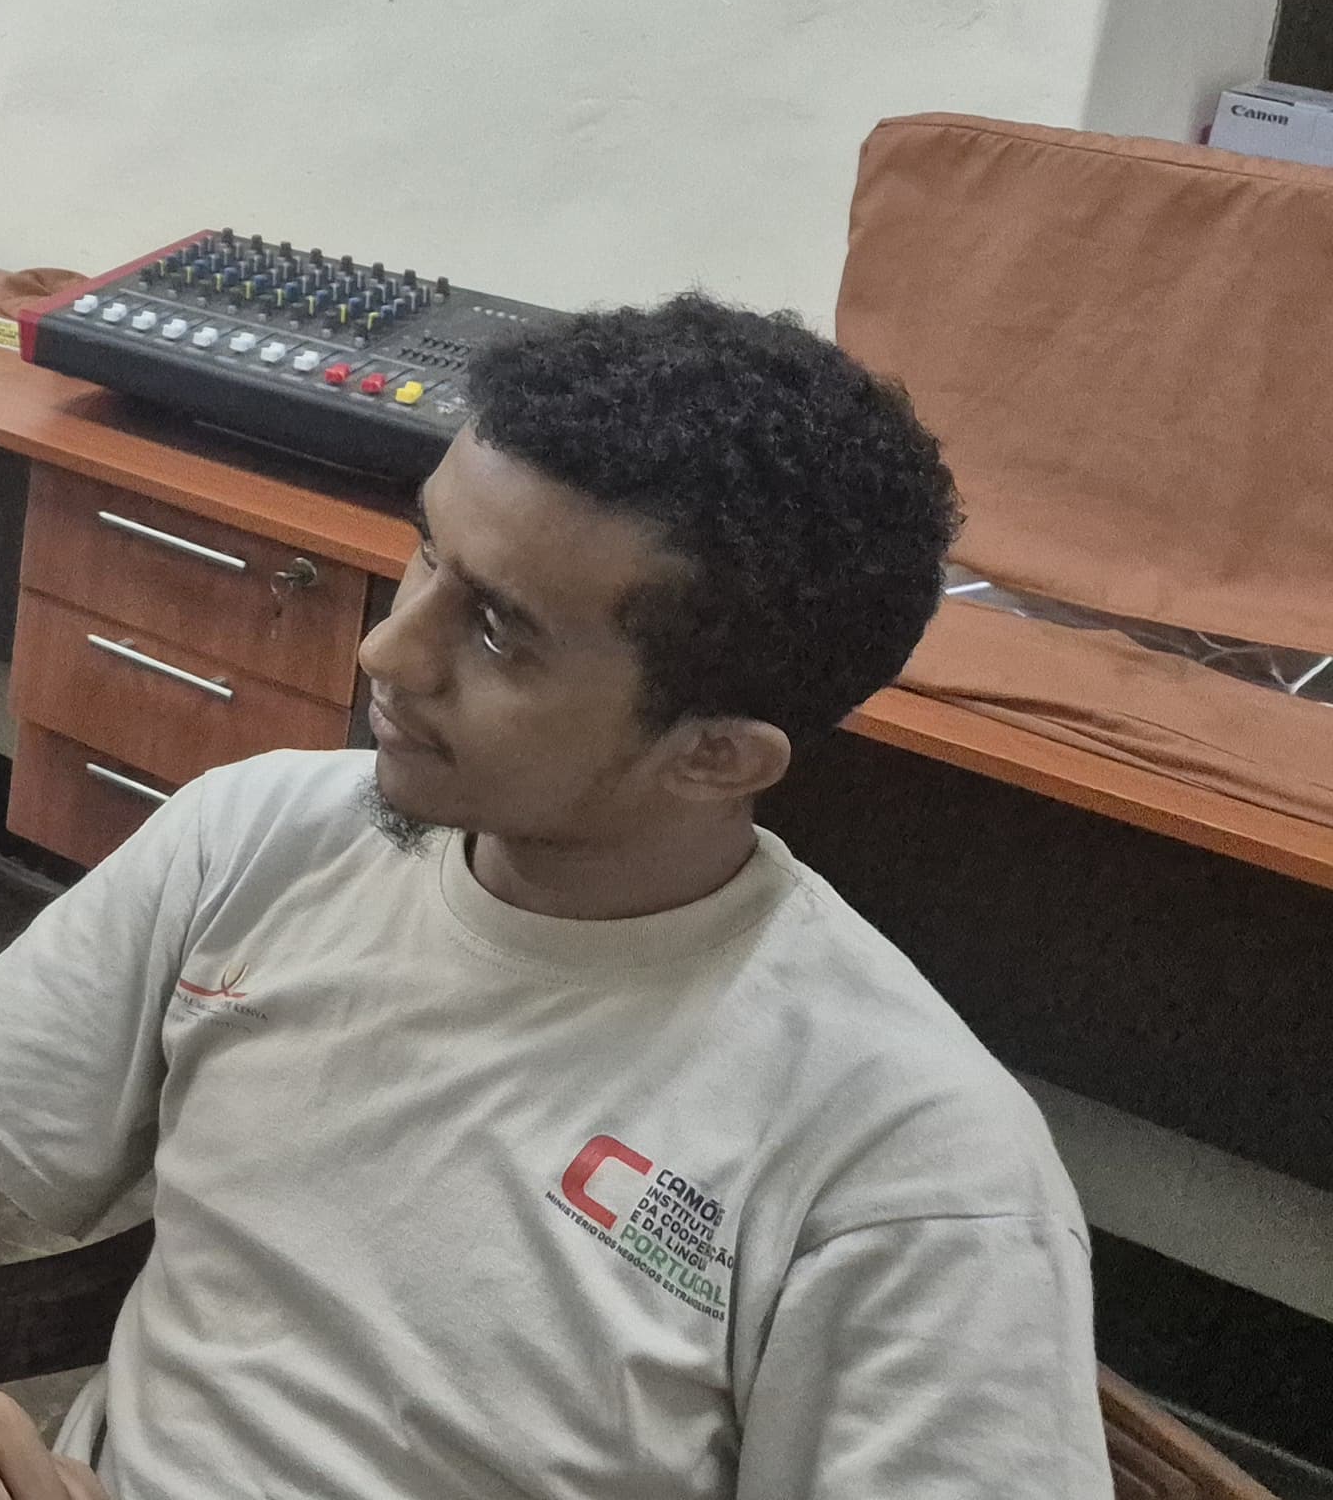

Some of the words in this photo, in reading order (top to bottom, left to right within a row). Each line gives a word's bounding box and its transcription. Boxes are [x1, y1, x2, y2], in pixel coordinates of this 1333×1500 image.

[1230, 104, 1289, 126] Canon
[637, 1197, 657, 1218] DA
[630, 1210, 642, 1224] E
[641, 1219, 663, 1241] DA
